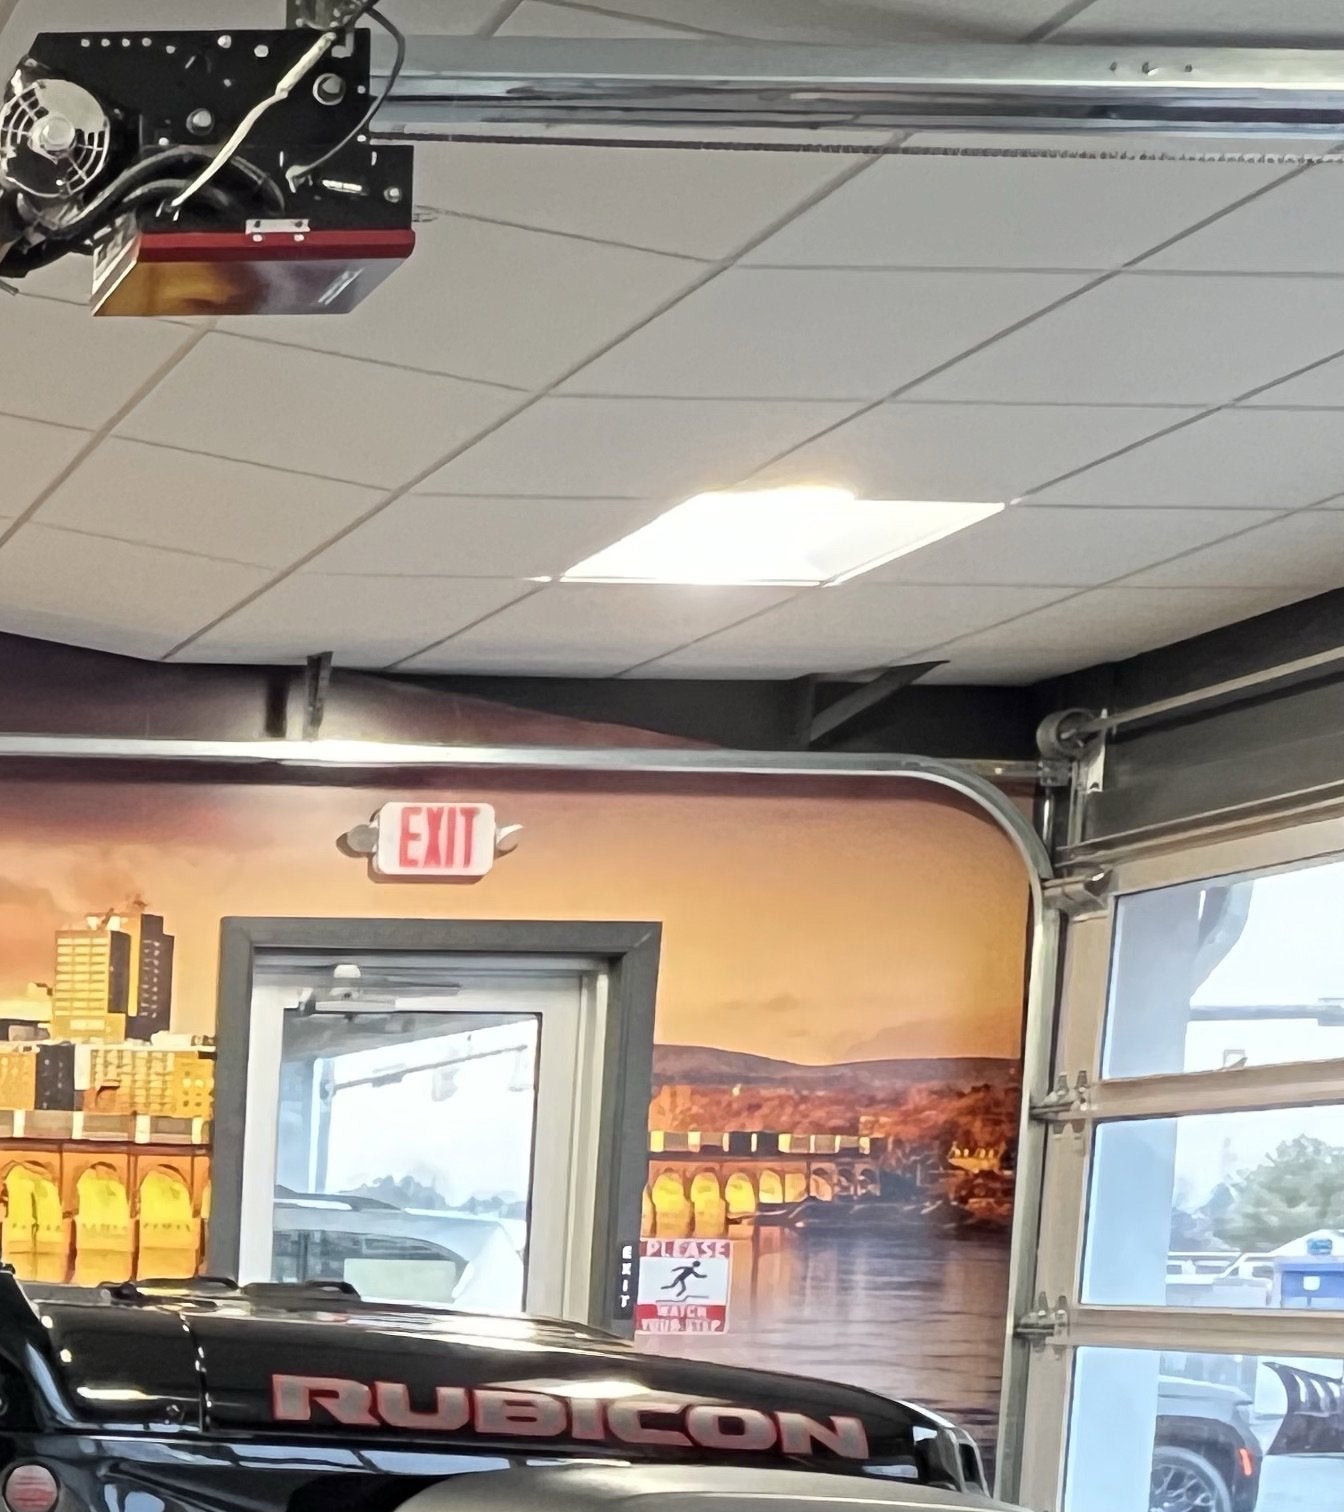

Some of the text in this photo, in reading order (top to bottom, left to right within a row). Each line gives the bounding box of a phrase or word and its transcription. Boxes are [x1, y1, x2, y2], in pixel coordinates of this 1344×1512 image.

[399, 806, 480, 868] EXIT
[620, 1245, 633, 1308] EXIT
[646, 1240, 726, 1258] PLEASE
[271, 1373, 869, 1459] RUBICON
